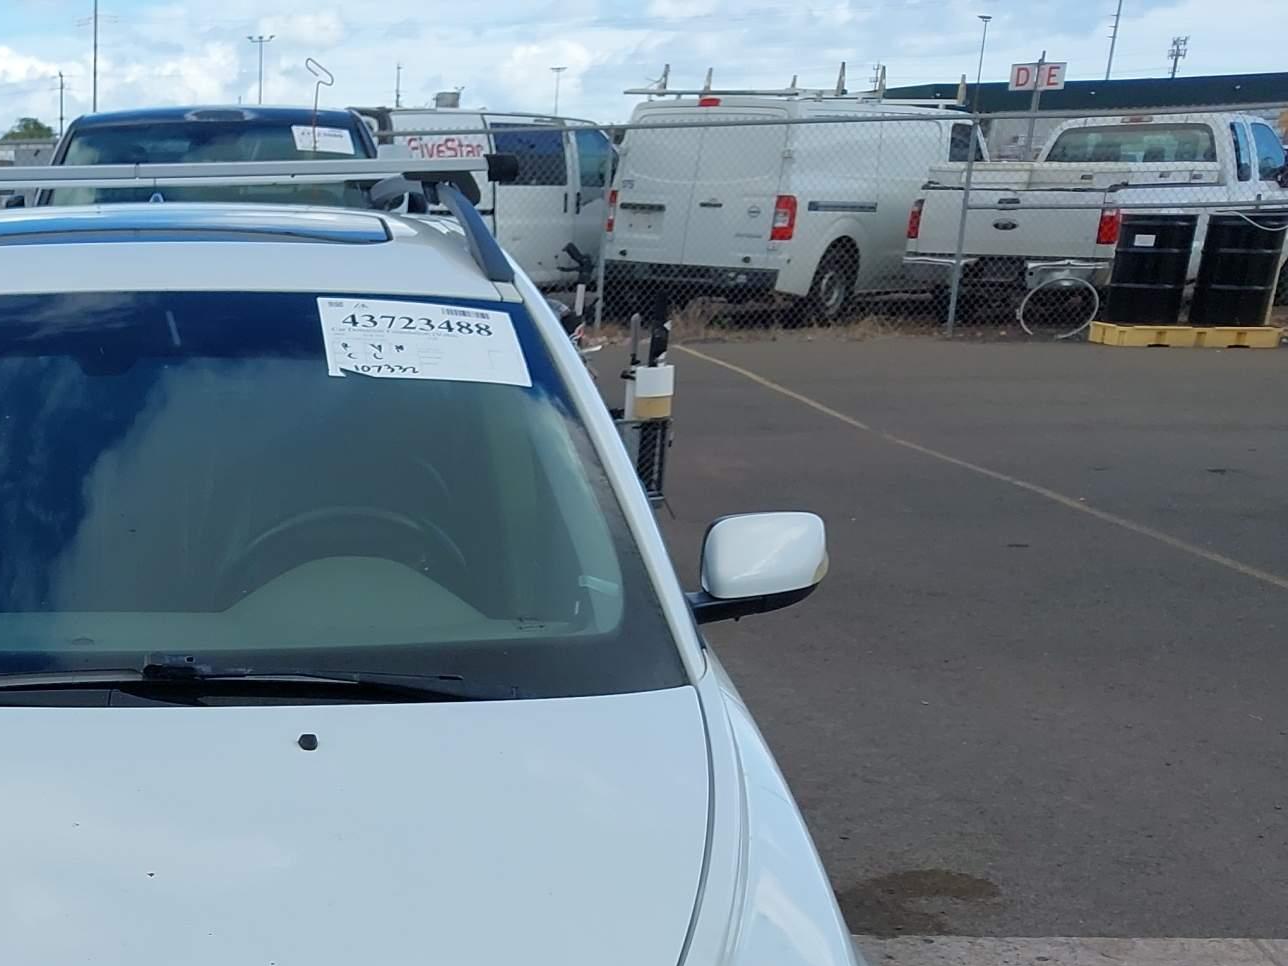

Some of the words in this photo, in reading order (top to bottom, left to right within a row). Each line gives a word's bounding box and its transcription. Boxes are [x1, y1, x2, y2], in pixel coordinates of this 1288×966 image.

[1015, 67, 1030, 87] D
[1047, 66, 1061, 86] E
[341, 313, 493, 338] 43723488
